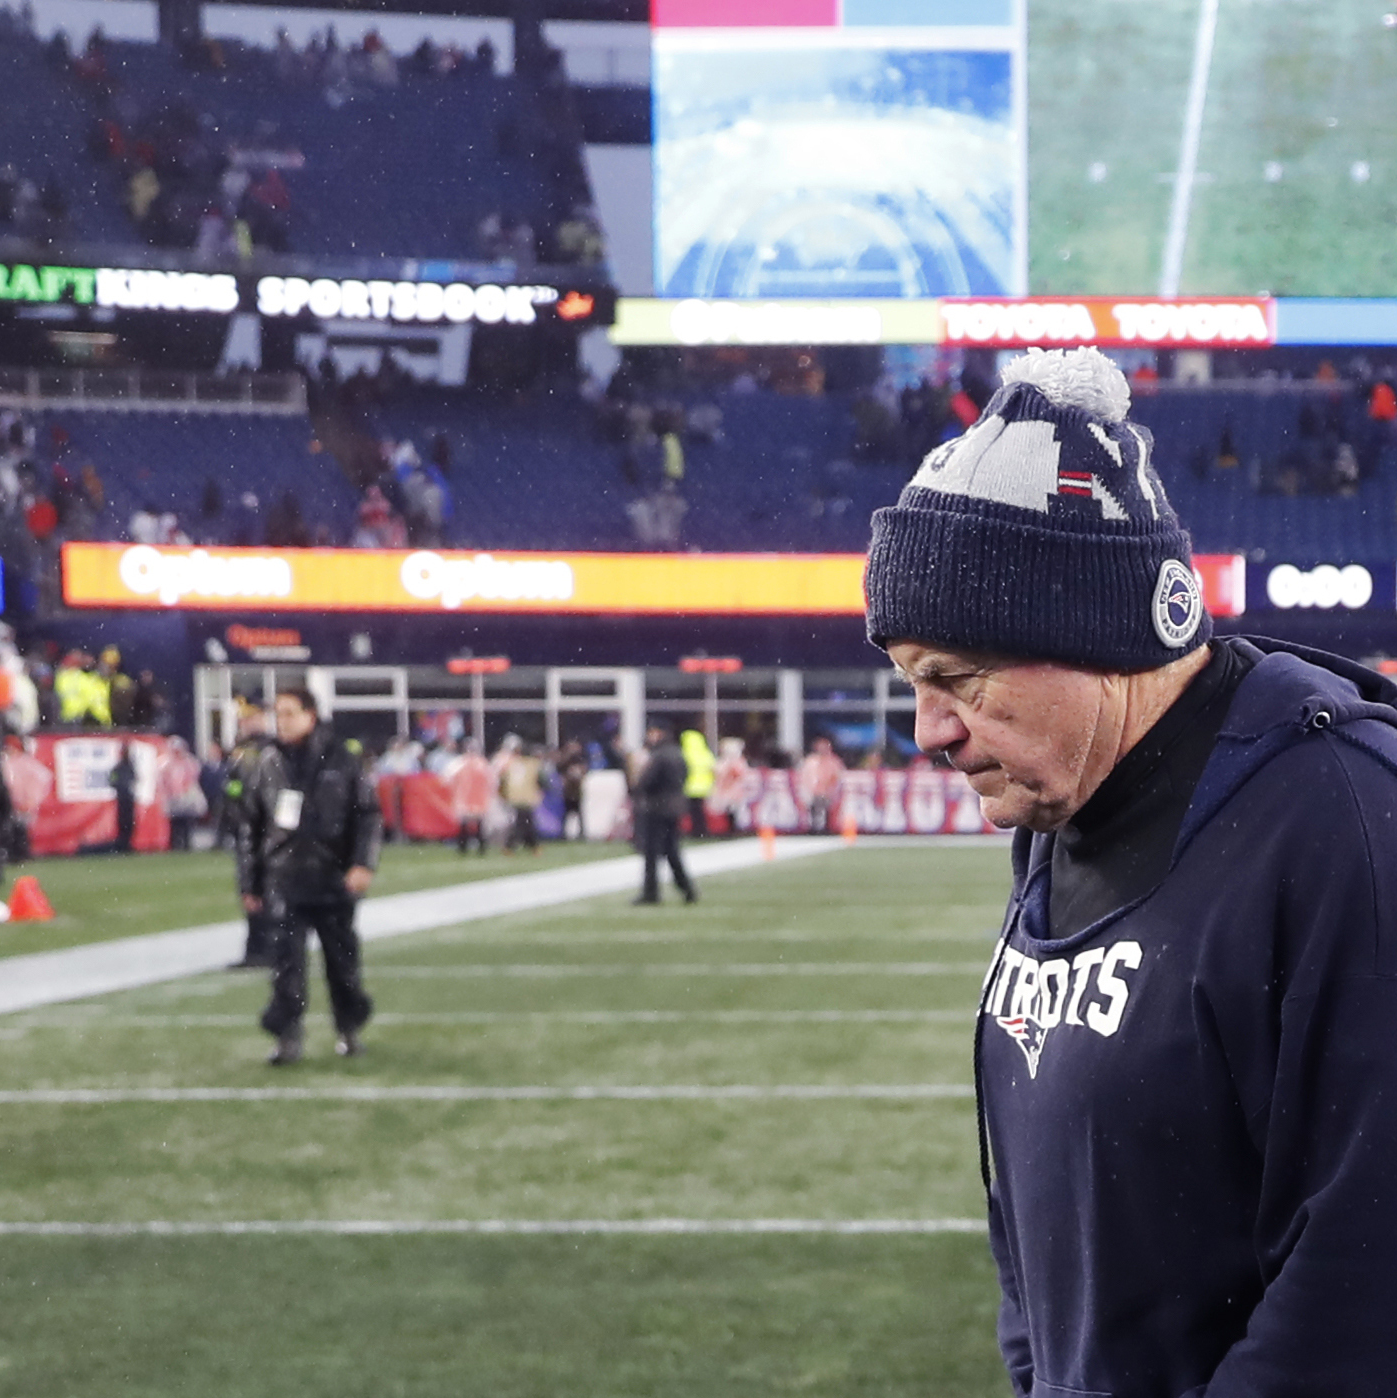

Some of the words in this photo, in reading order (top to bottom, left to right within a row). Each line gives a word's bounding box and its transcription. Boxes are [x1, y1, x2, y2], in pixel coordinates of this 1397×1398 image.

[257, 277, 536, 324] SPORTSBOOK
[941, 302, 1096, 341] TOYOTA
[1112, 303, 1269, 341] TOYOTA
[119, 545, 292, 605] Optum
[400, 551, 574, 609] Optum
[1268, 565, 1372, 607] 0:00
